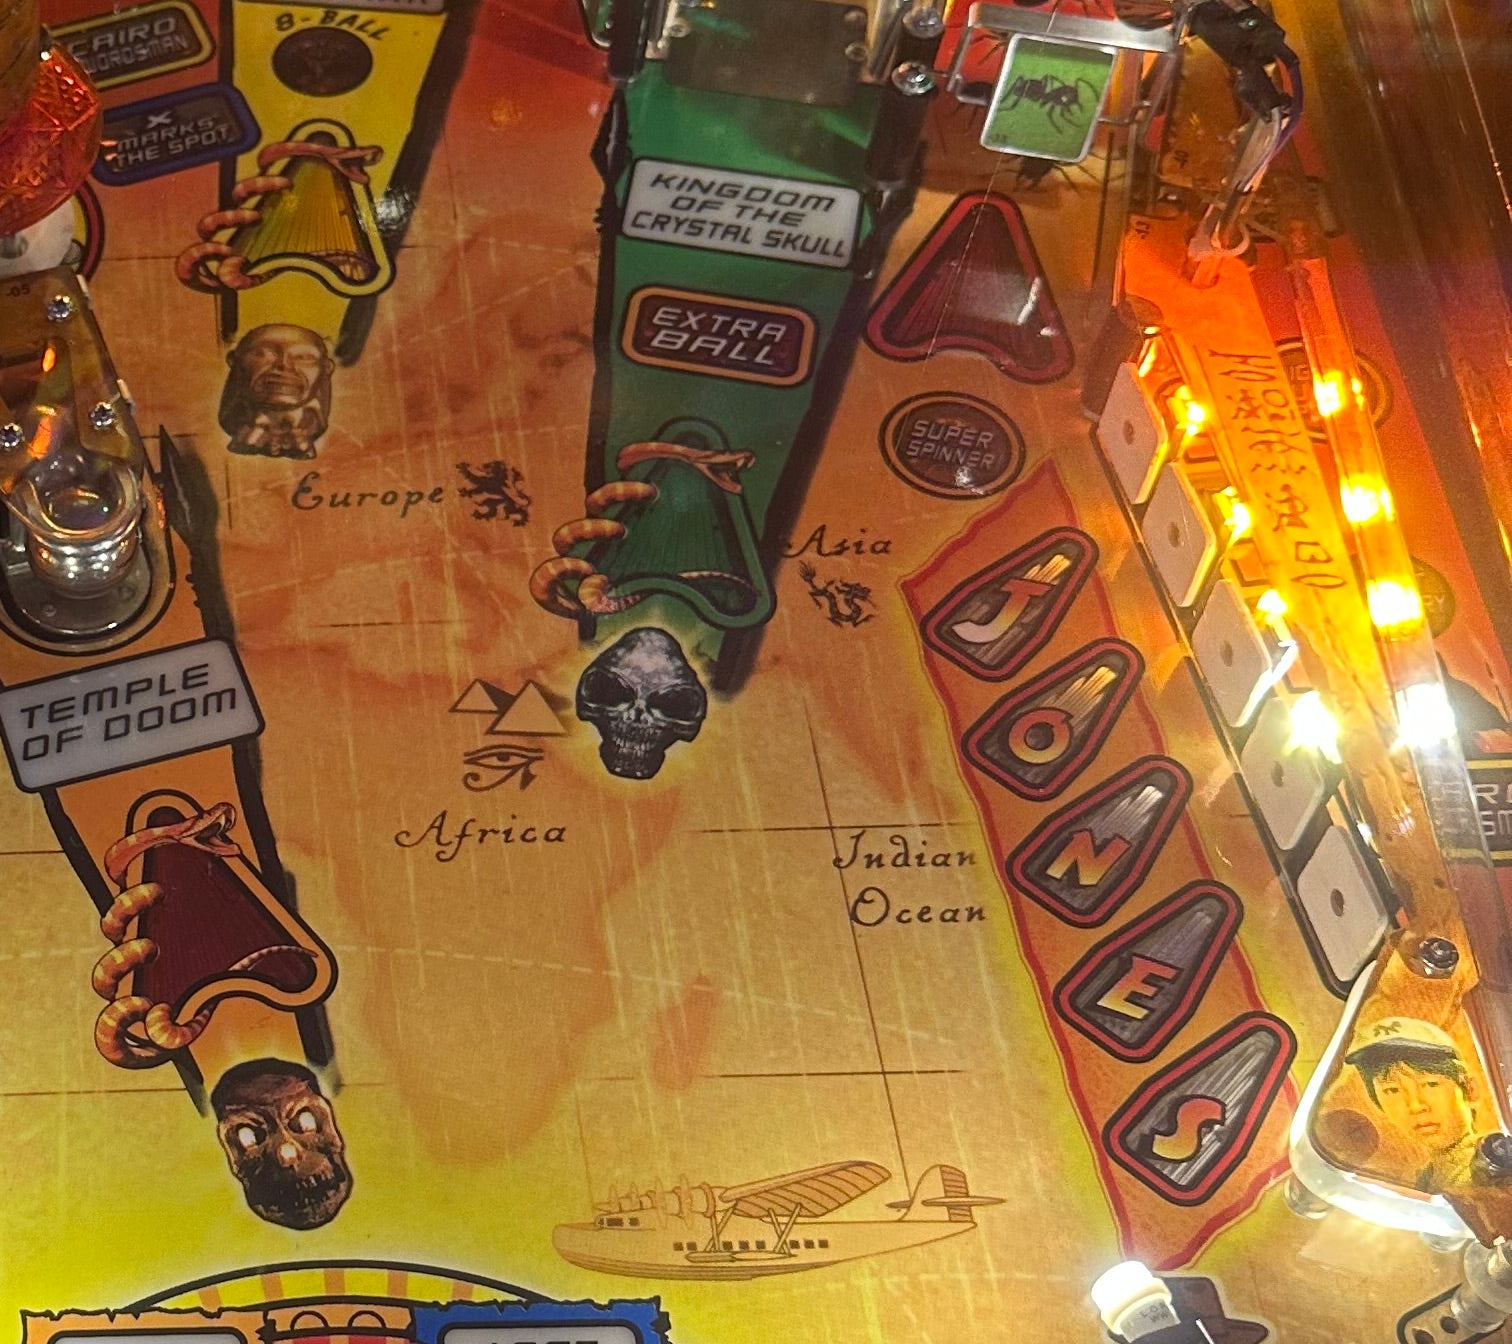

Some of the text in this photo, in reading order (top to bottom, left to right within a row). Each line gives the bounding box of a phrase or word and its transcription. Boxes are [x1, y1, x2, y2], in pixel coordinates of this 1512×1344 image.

[68, 16, 178, 57] CAIRO
[117, 116, 216, 163] MARKS
[146, 110, 173, 130] X
[114, 124, 235, 168] THE SPOT
[650, 172, 837, 213] KINGDOM
[670, 195, 808, 228] OF THE
[631, 210, 846, 259] CRYSTAL SKULL
[651, 306, 788, 343] EXTRA
[649, 329, 775, 366] BALL
[905, 439, 995, 470] SPINNER
[910, 419, 994, 451] SUPER
[290, 470, 445, 519] Europe
[785, 523, 893, 558] Asia
[20, 662, 210, 730] TEMPLE
[22, 687, 237, 762] OF DOOM
[393, 809, 568, 863] Africa
[833, 829, 979, 873] Indian
[952, 577, 1228, 1163] J O N E S
[849, 886, 989, 928] Ocean
